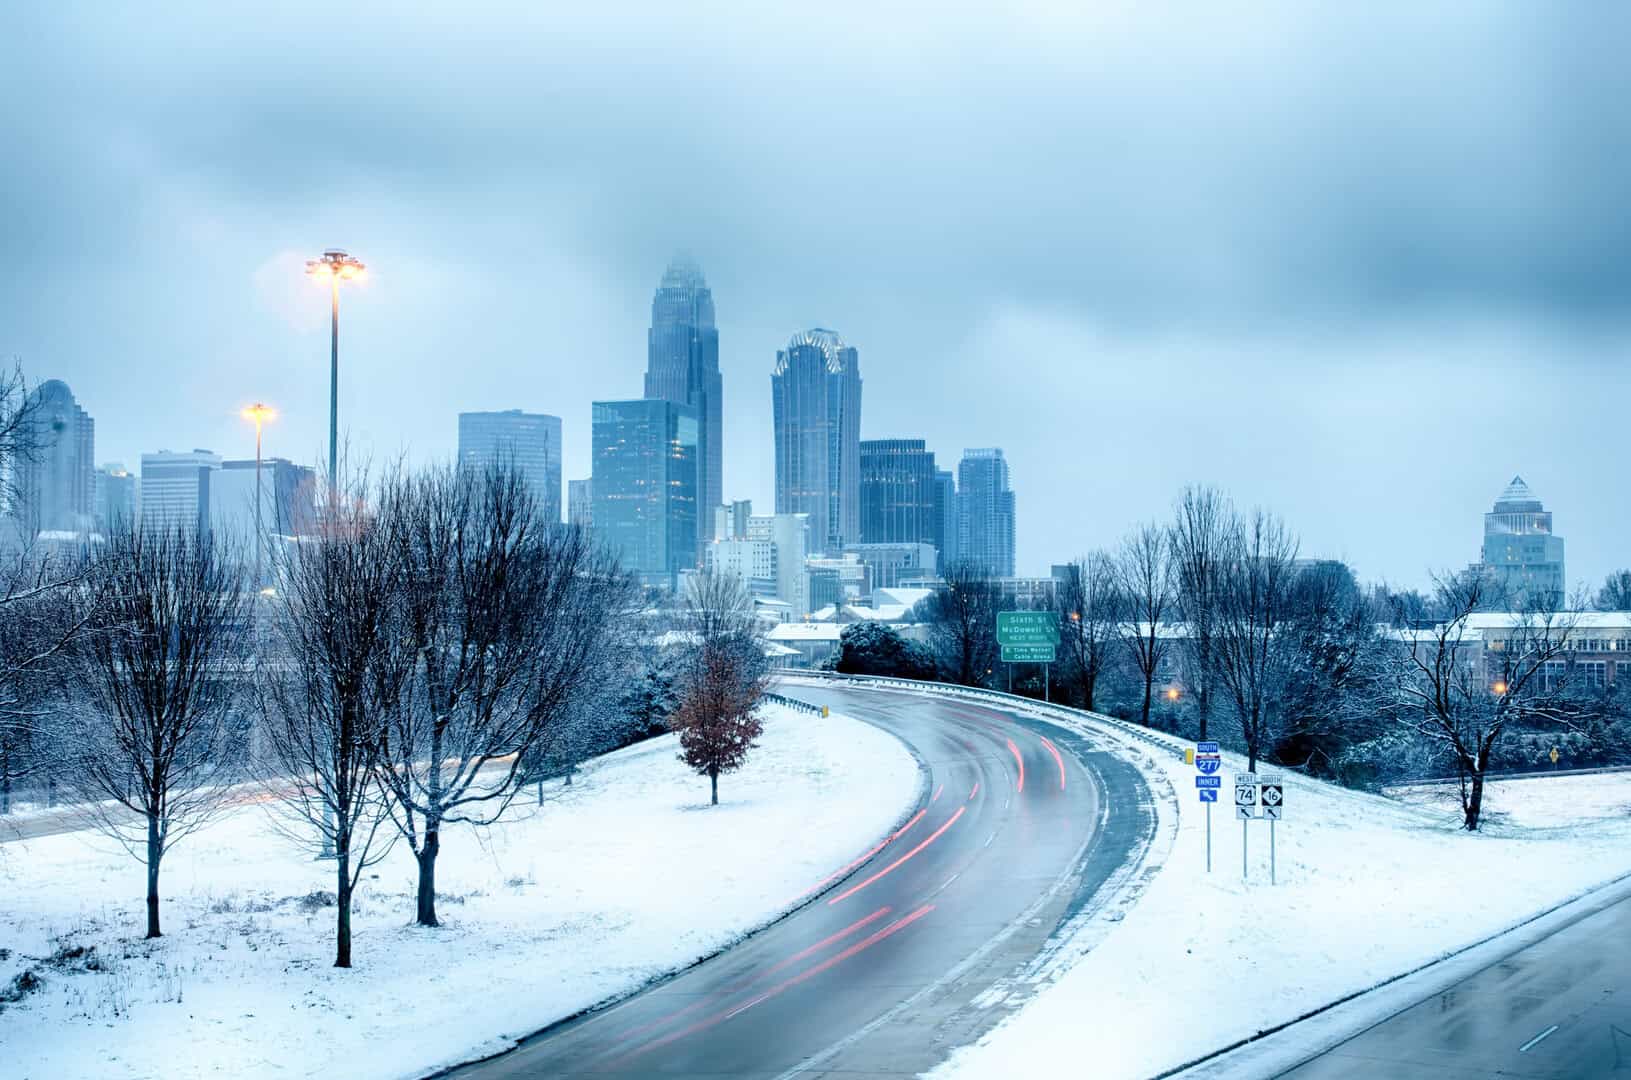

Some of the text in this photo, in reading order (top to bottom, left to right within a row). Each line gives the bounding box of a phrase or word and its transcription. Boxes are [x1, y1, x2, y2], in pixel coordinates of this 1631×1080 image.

[1009, 616, 1034, 624] Sixth
[1198, 744, 1217, 752] SOUTH
[1199, 761, 1219, 770] 277
[1198, 777, 1219, 786] INNER
[1238, 789, 1253, 801] 74
[1268, 791, 1278, 801] 16
